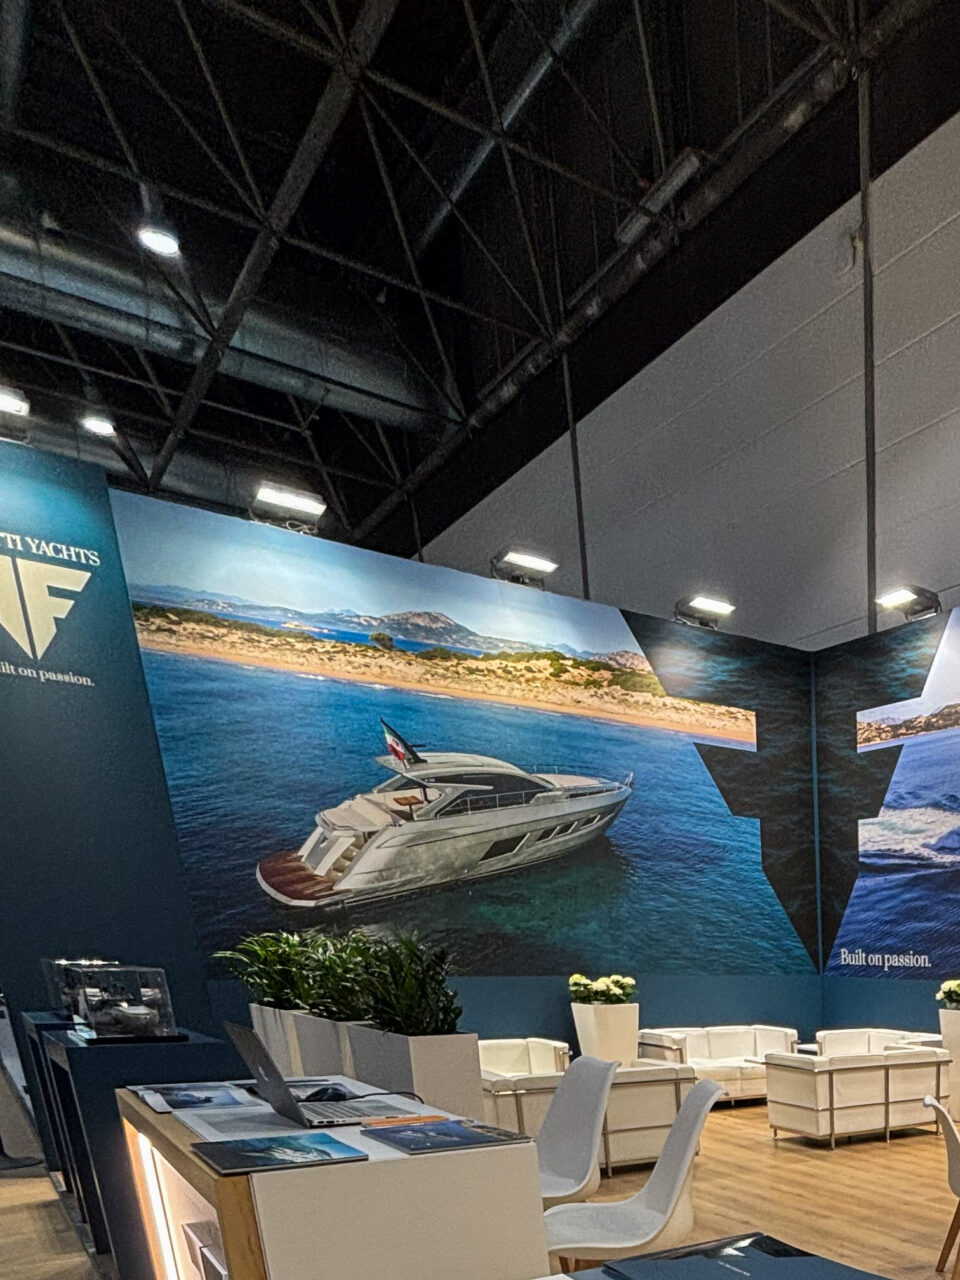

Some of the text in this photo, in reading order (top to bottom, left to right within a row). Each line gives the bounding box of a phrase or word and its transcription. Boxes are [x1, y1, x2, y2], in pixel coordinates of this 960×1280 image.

[25, 536, 100, 566] YACHTS
[18, 665, 37, 678] on
[39, 669, 95, 686] passion.
[840, 948, 932, 971] Built on passion.
